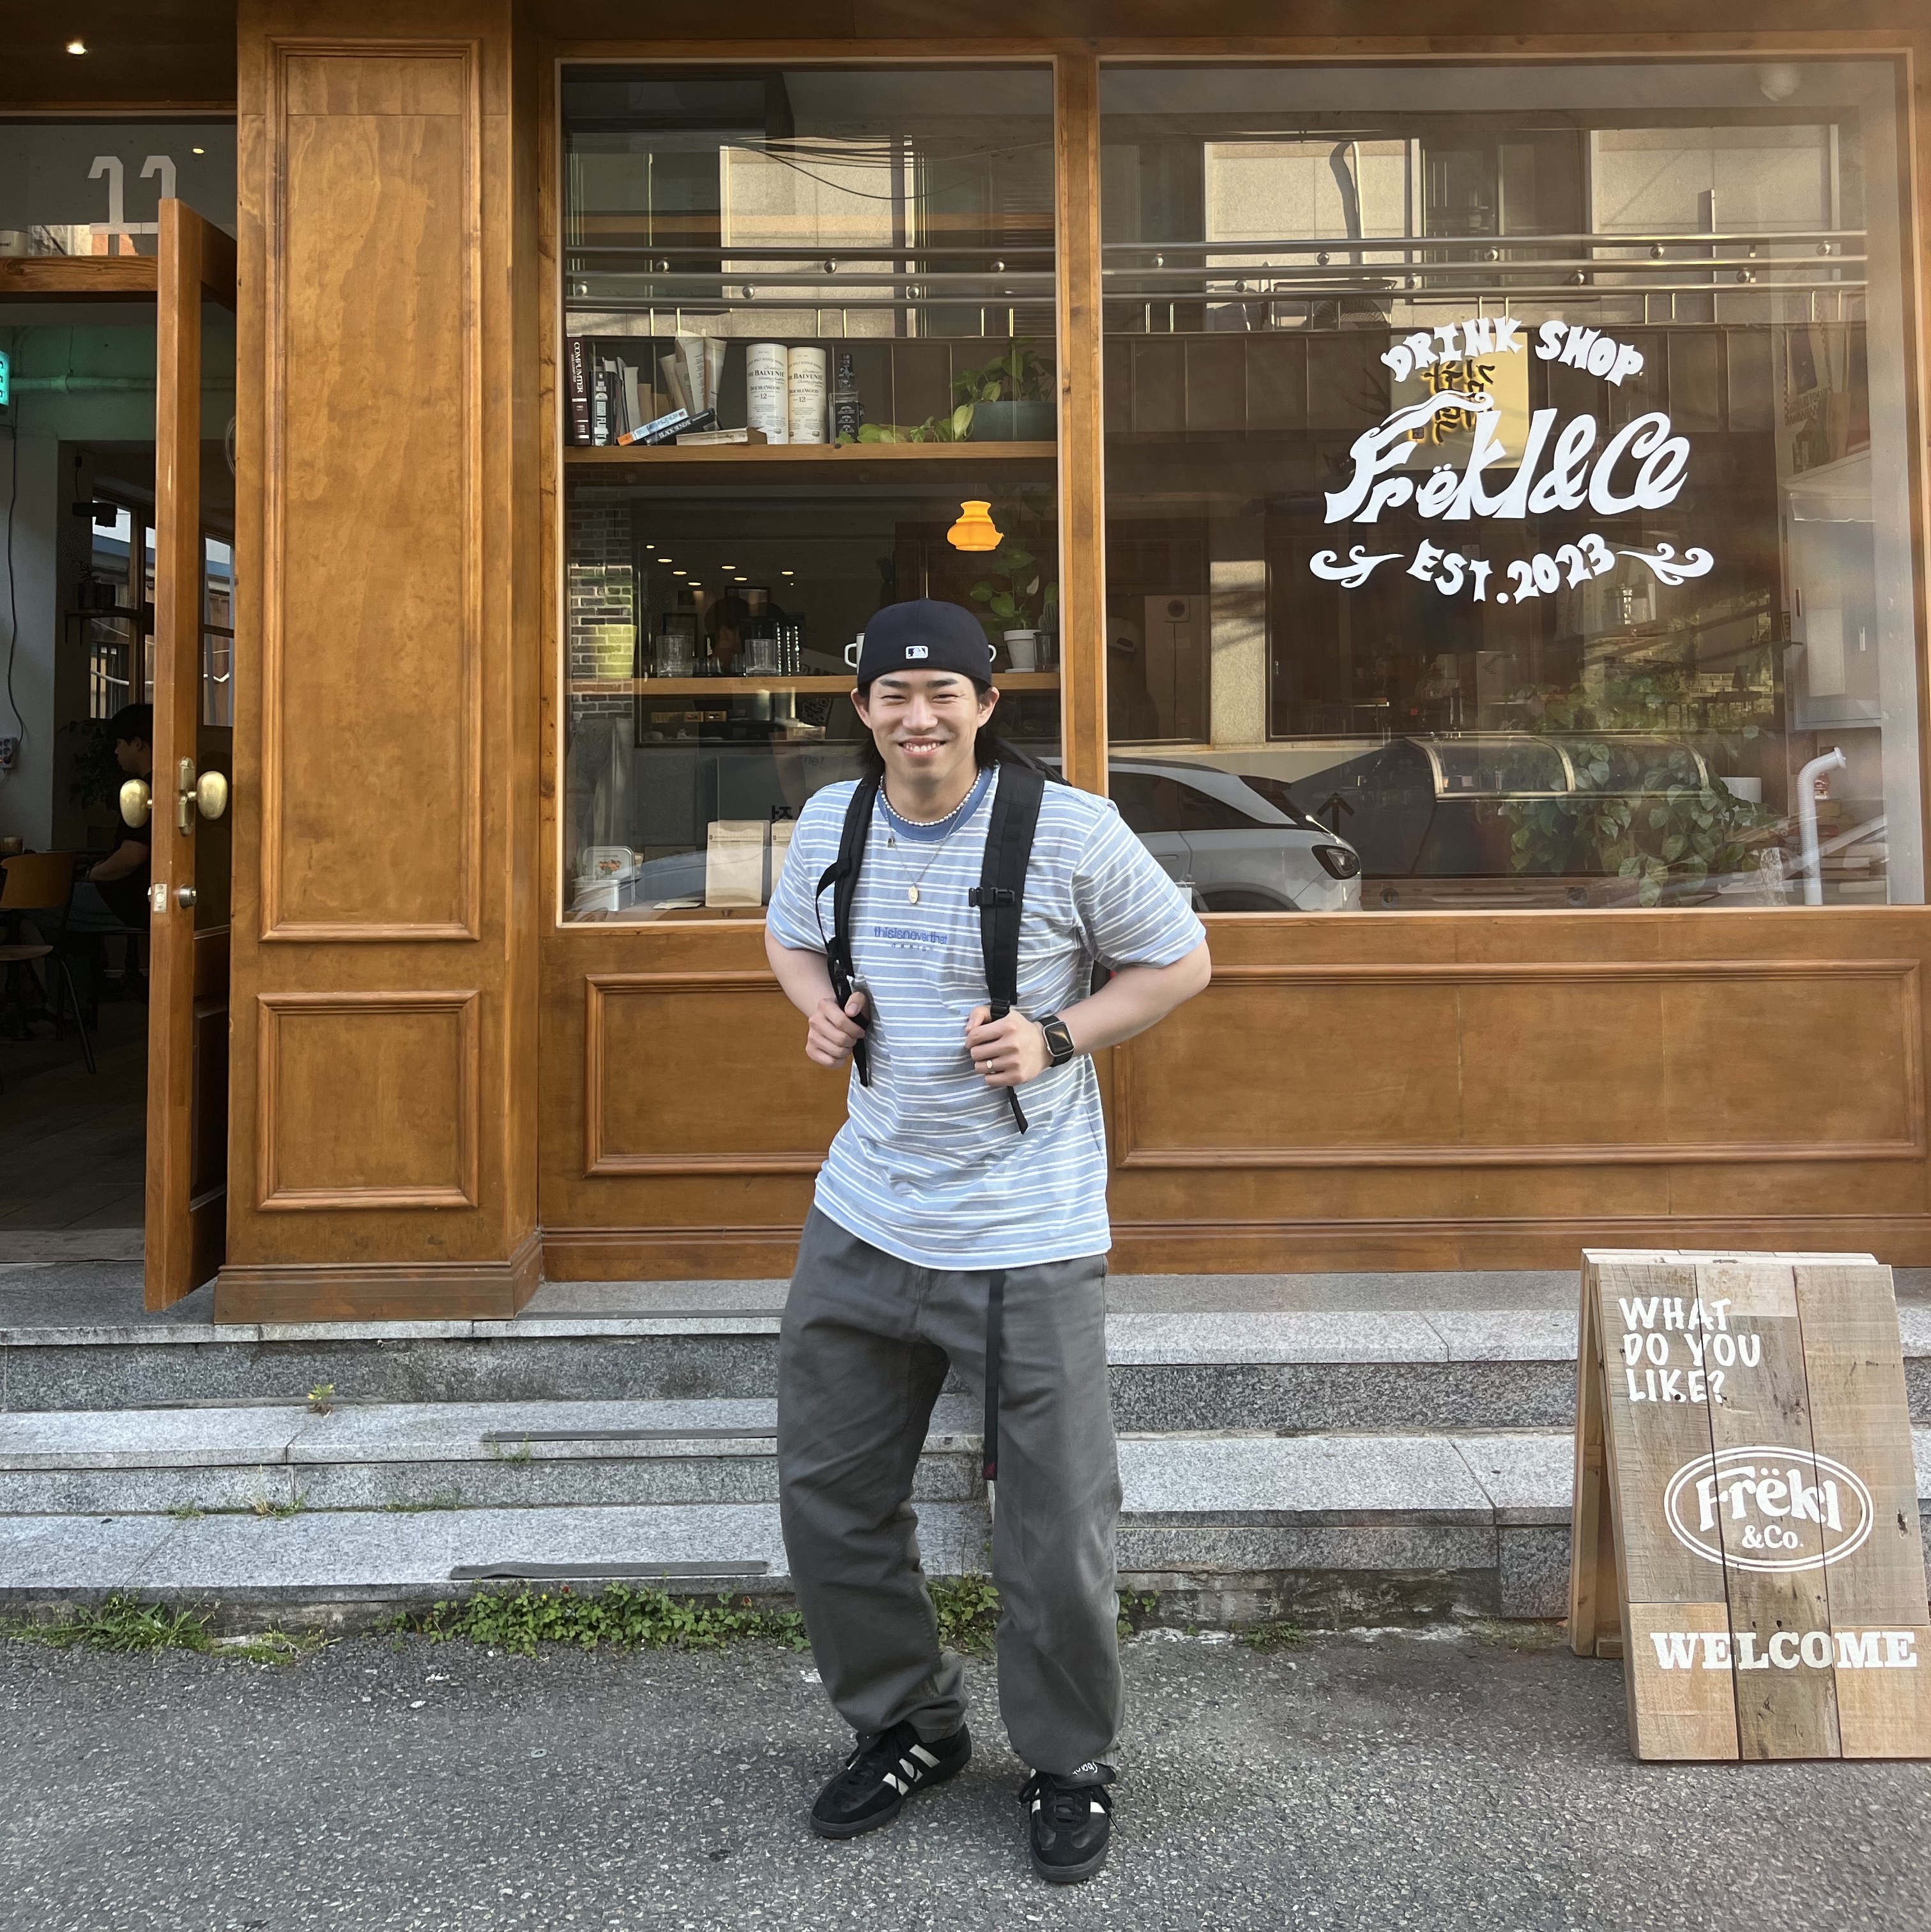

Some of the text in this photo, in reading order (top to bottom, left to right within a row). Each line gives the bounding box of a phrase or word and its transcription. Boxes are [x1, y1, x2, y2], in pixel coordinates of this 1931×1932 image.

[1380, 316, 1644, 387] DRINK SHOP
[1617, 1296, 1731, 1331] WHAT
[1622, 1333, 1760, 1368] DO YOU
[1625, 1368, 1725, 1404] LIKE?
[1695, 1466, 1843, 1533] Frëkl
[1741, 1524, 1805, 1550] &Co.
[1650, 1630, 1918, 1670] WELCOME
